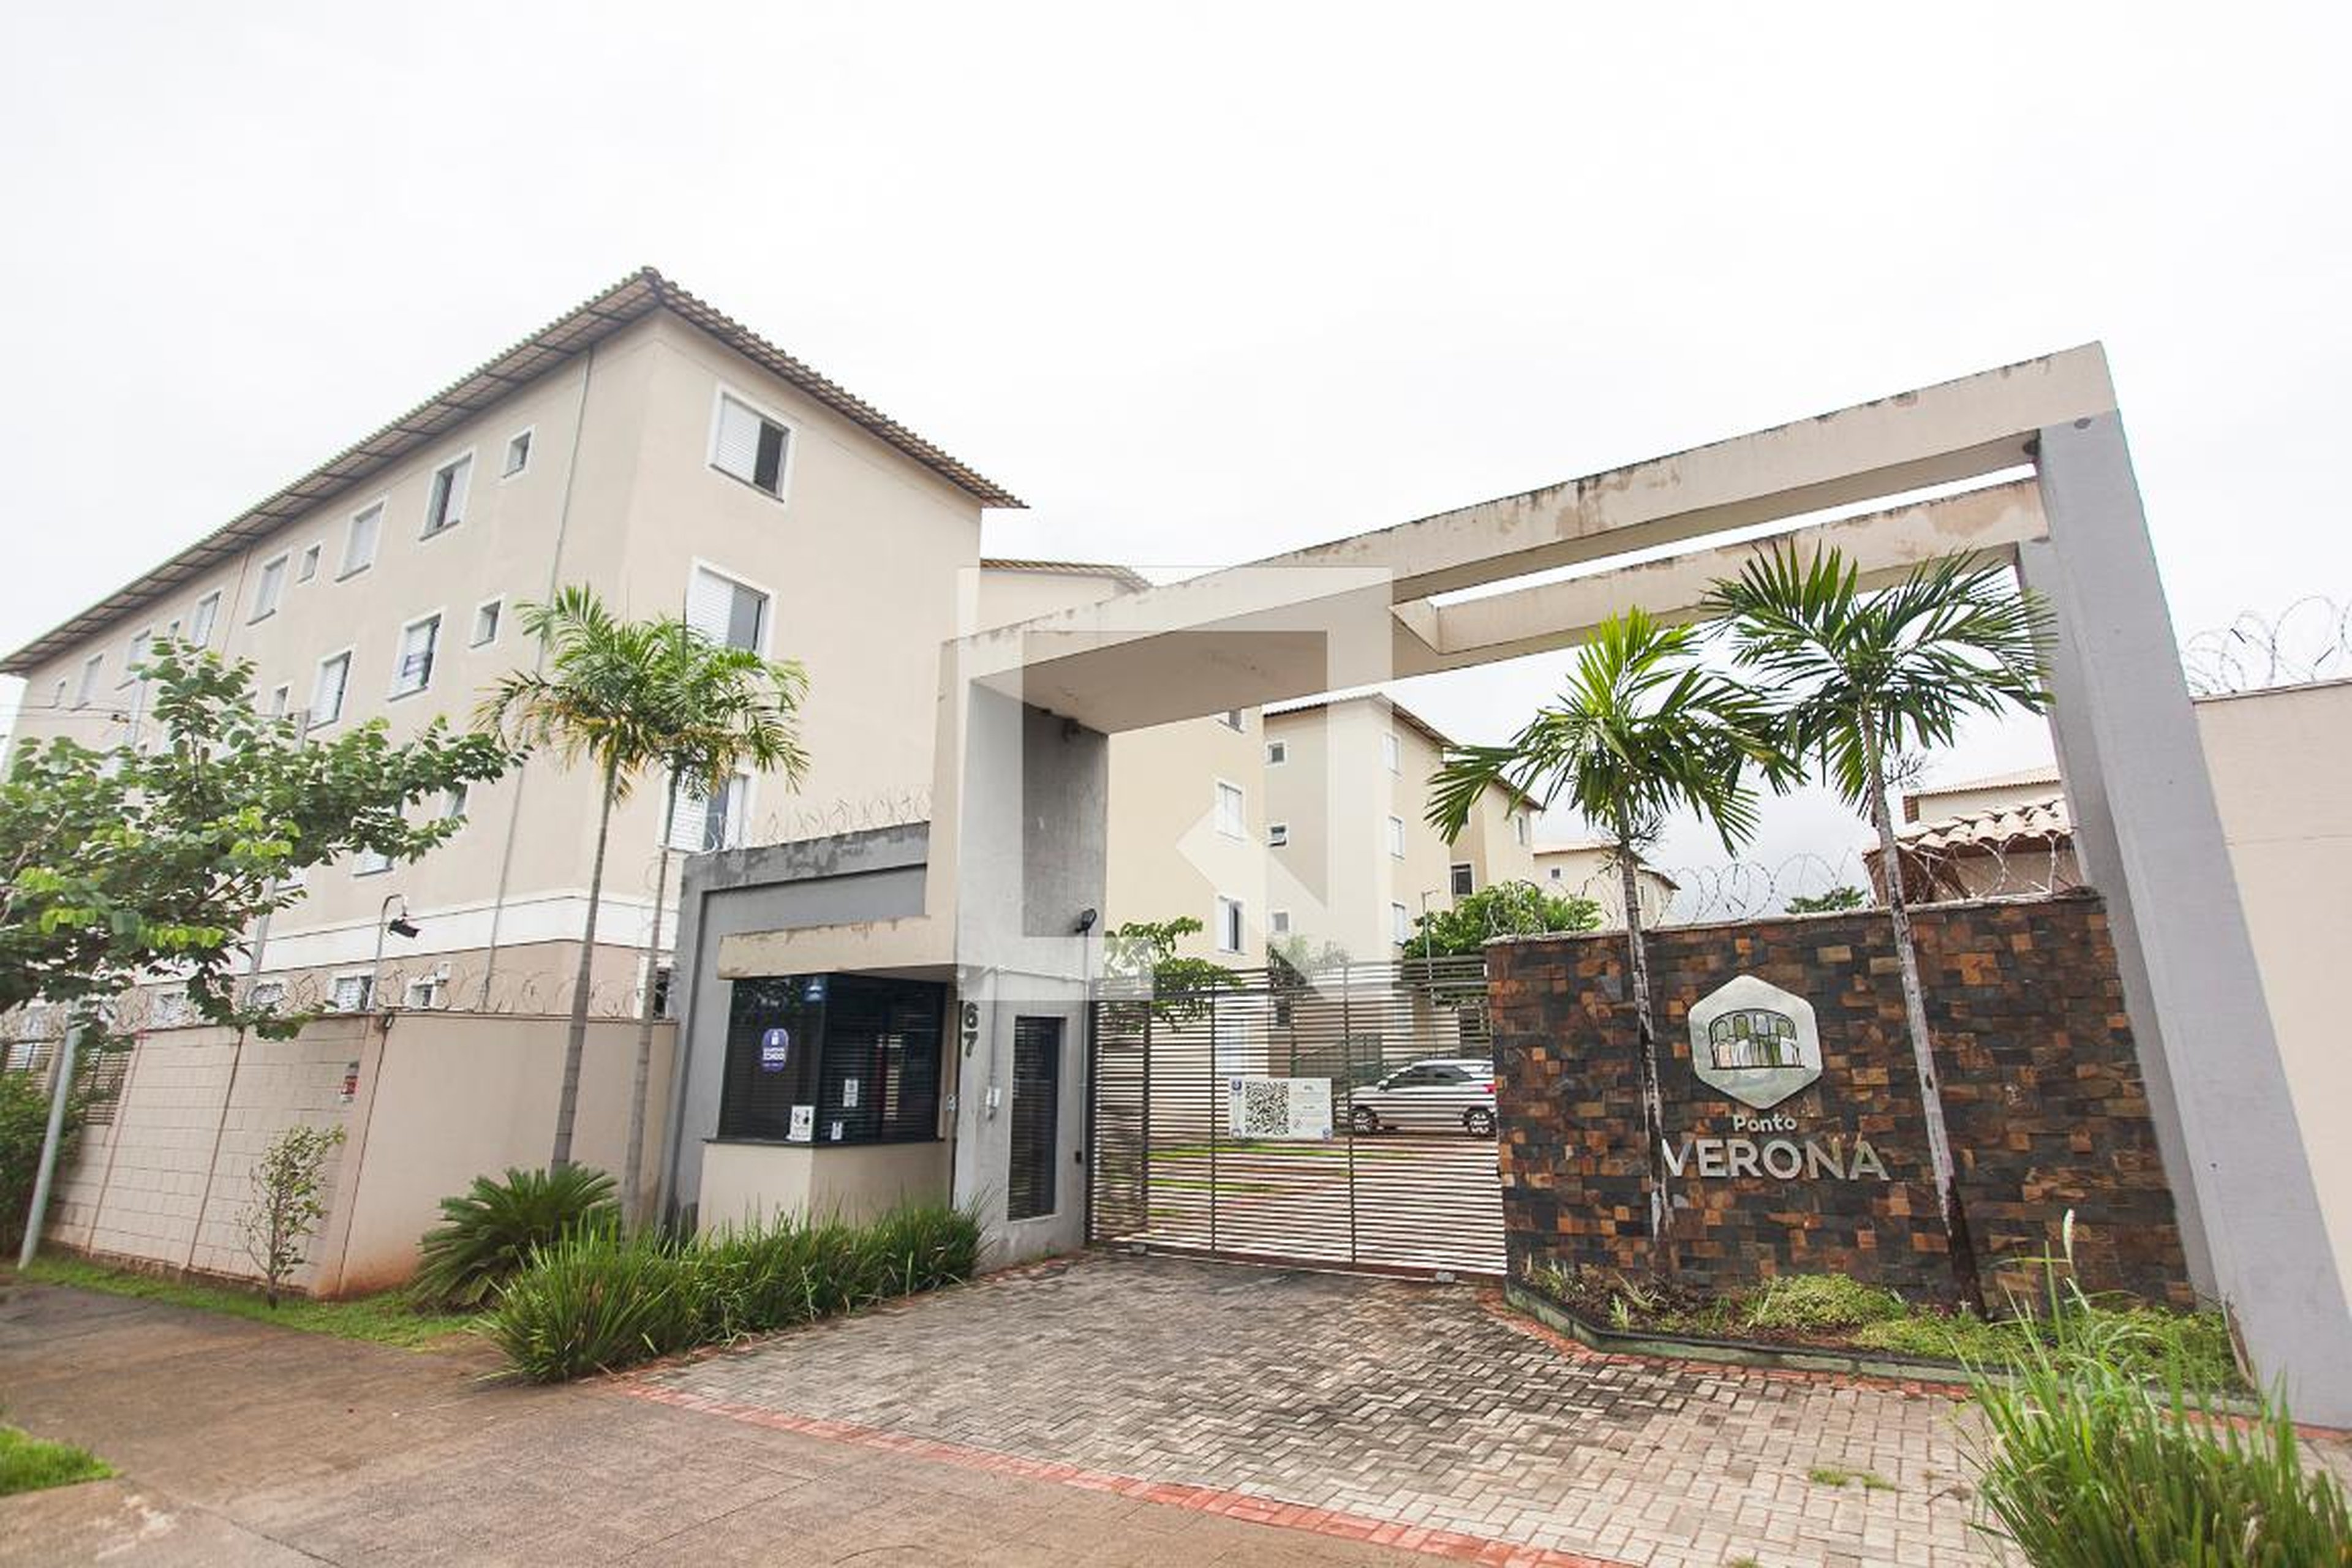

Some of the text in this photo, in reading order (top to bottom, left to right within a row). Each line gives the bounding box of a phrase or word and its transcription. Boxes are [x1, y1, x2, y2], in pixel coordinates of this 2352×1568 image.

[963, 1002, 979, 1058] 67
[1732, 1113, 1797, 1132] Ponto
[1661, 1138, 1891, 1181] VERONA
